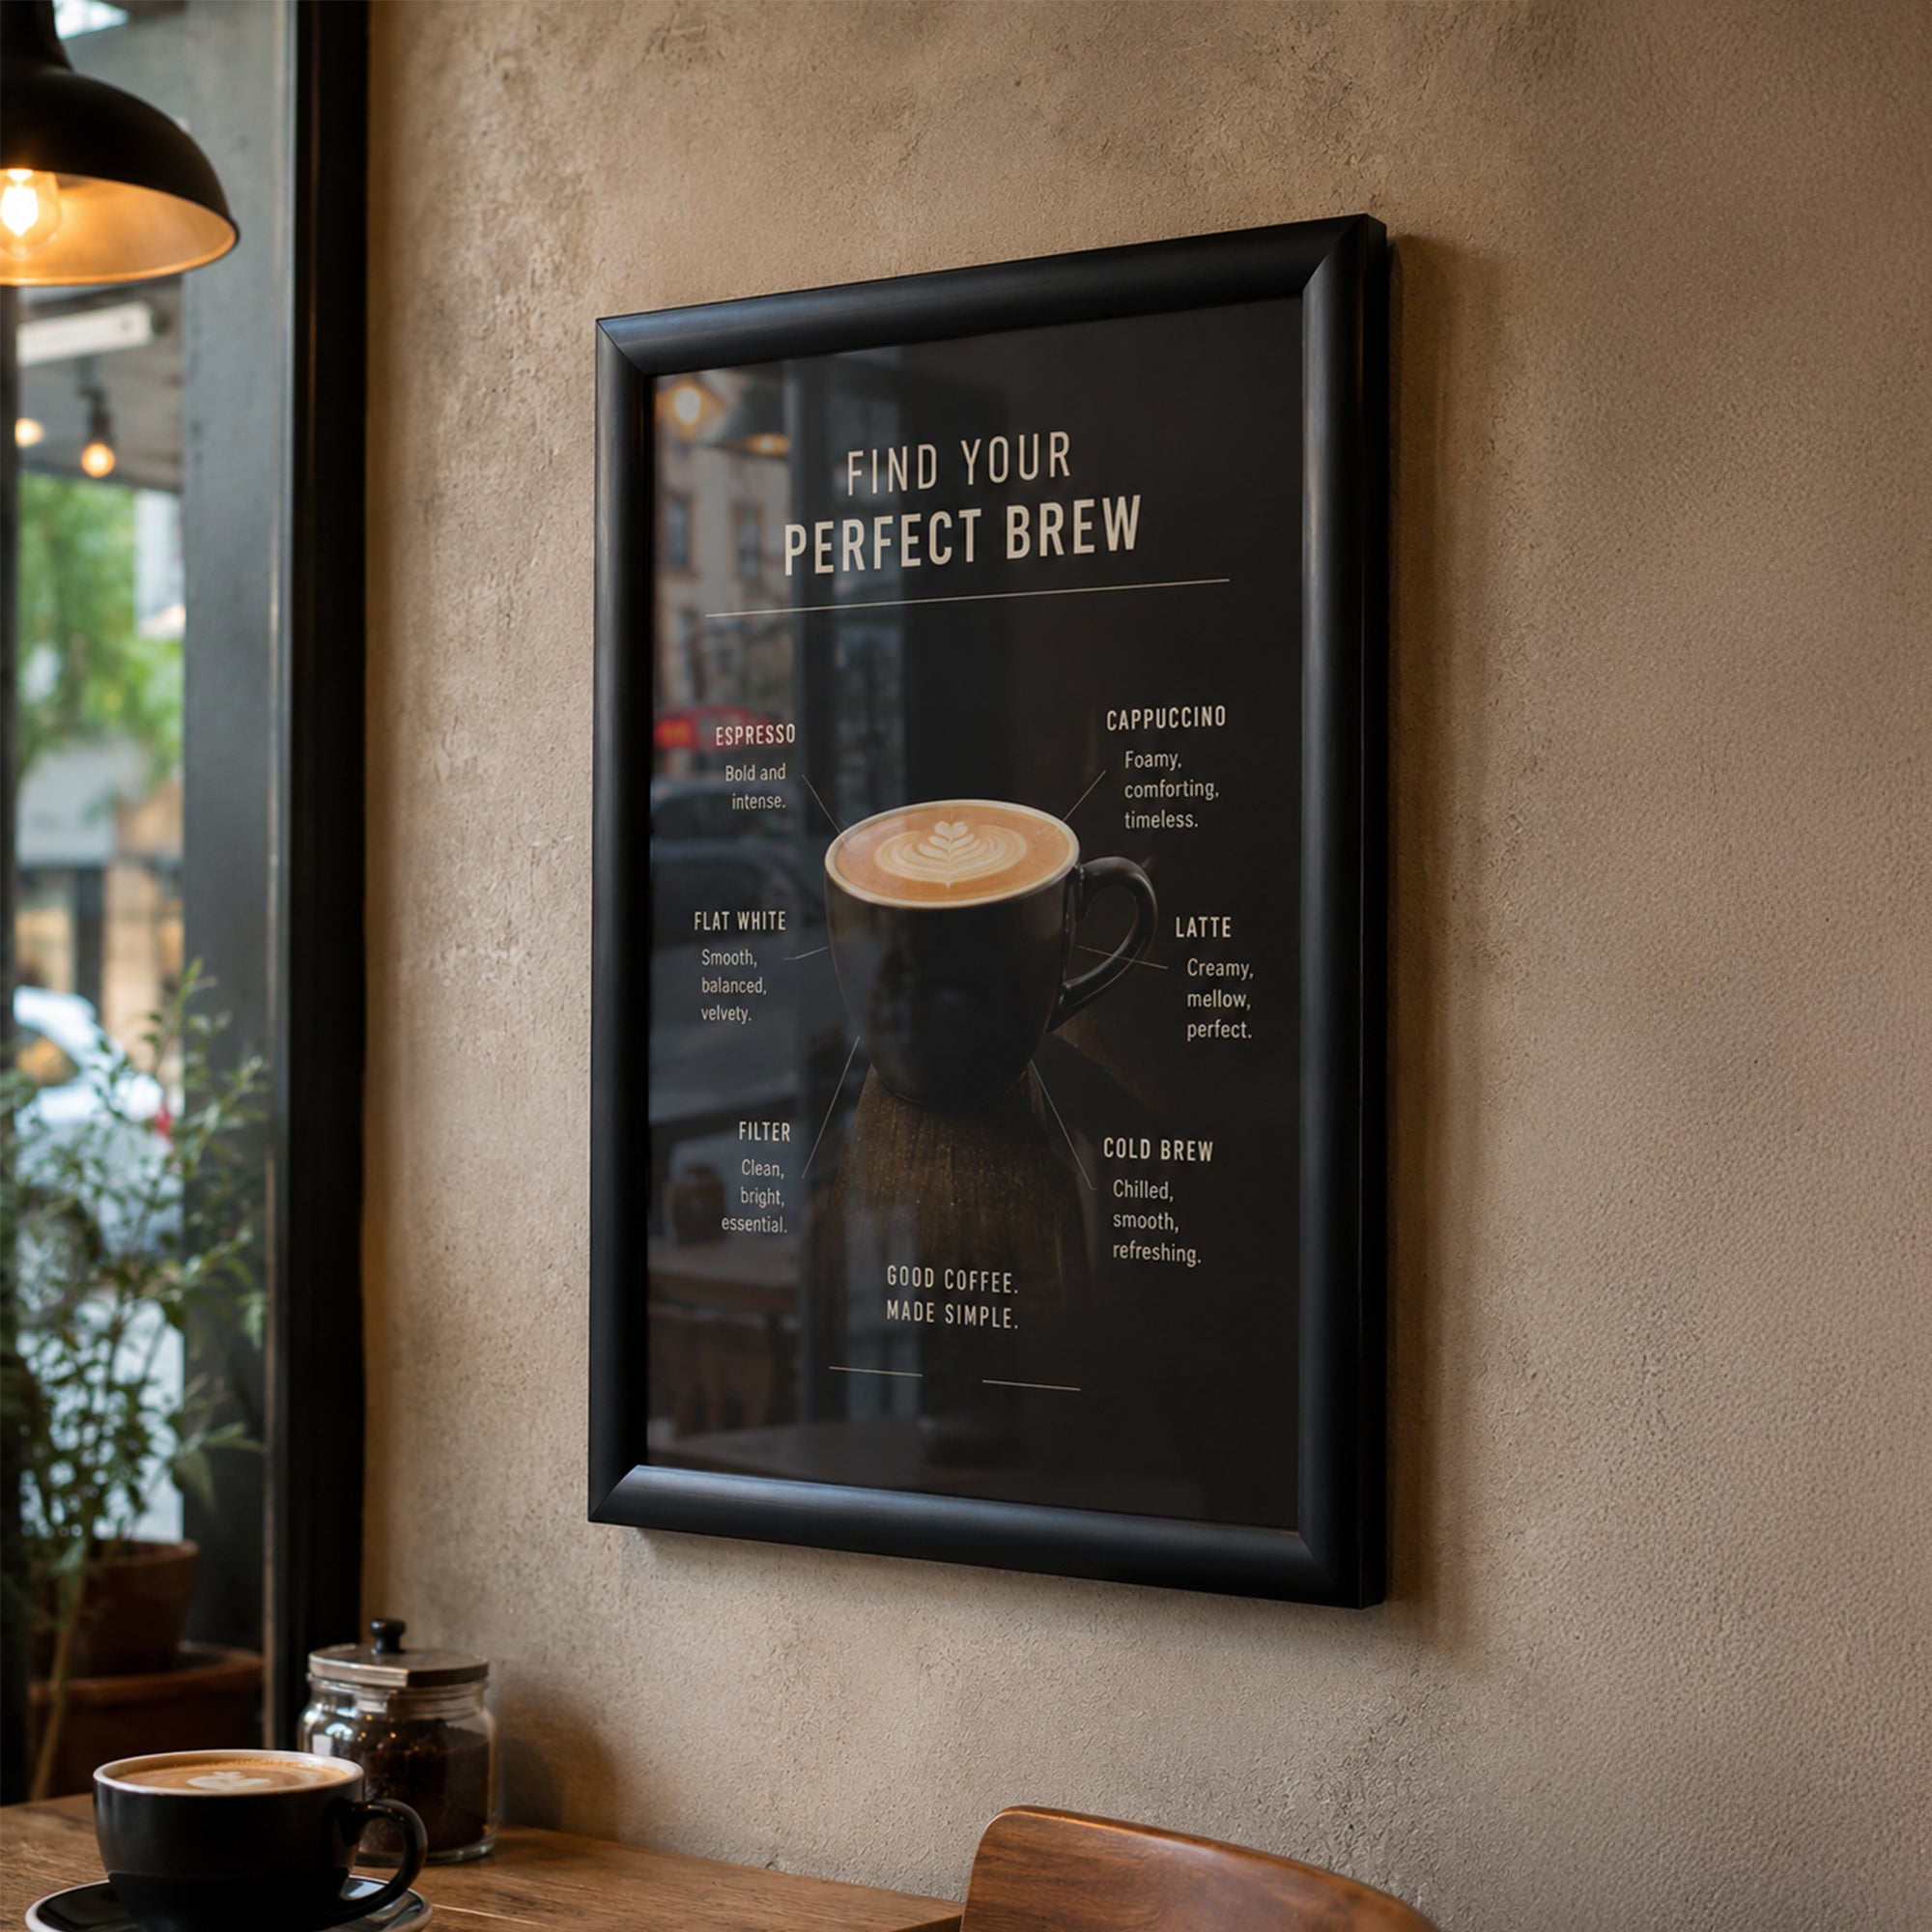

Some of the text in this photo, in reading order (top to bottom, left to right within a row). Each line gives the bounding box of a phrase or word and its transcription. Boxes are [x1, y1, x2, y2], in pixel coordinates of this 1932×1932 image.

[846, 431, 1070, 497] FIND YOUR
[783, 494, 1141, 578] PERFECT BREW
[1106, 704, 1226, 731] CAPPUCCINO
[715, 723, 796, 747] ESPRESSO
[724, 762, 786, 782] Bold and
[731, 792, 786, 810] intense.
[1123, 778, 1219, 801] comforting,
[1123, 809, 1199, 830] timeless.
[694, 910, 786, 931] FLAT WHITE
[1176, 916, 1232, 938] LATTE
[701, 948, 757, 968] Smooth,
[1186, 957, 1254, 981] Creamy,
[701, 976, 767, 995] balanced,
[1187, 988, 1251, 1010] mellow,
[700, 1004, 752, 1025] velvety.
[1186, 1018, 1252, 1042] perfect.
[738, 1121, 790, 1142] FILTER
[1103, 1136, 1213, 1162] COLD BREW
[741, 1158, 784, 1179] Clean,
[740, 1185, 785, 1209] bright,
[1113, 1179, 1174, 1203] Chilled,
[721, 1215, 787, 1234] essential.
[1113, 1211, 1179, 1234] smooth,
[1113, 1240, 1202, 1268] refreshing.
[887, 1264, 1018, 1294] GOOD COFFEE.
[886, 1299, 1018, 1329] MADE SIMPLE.
